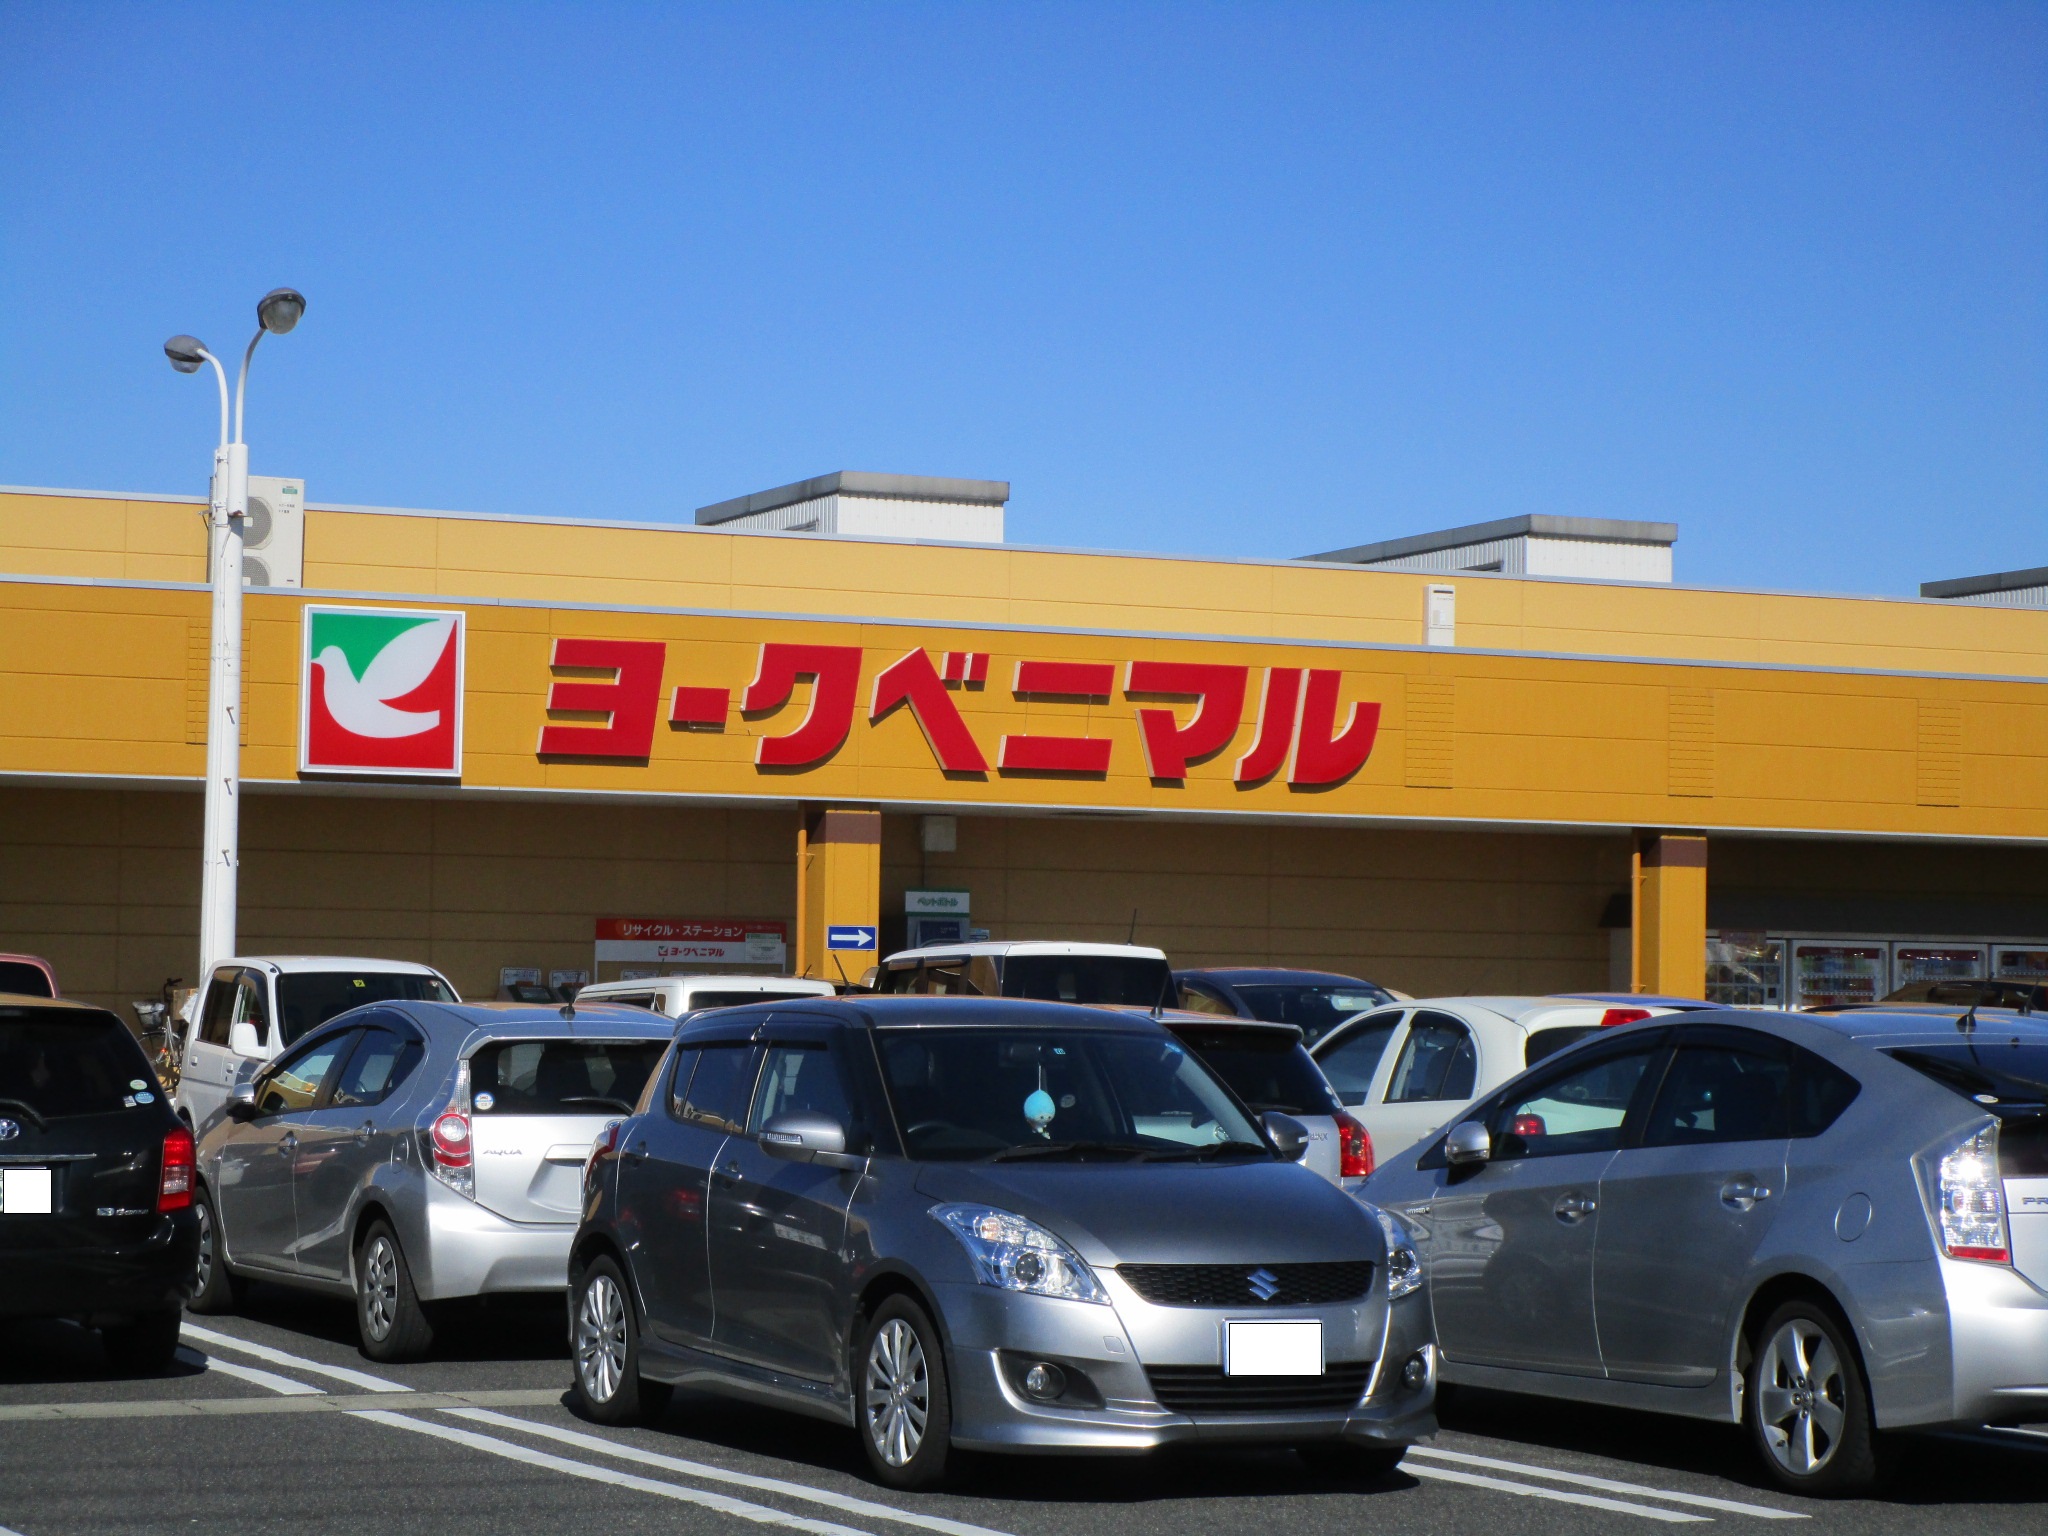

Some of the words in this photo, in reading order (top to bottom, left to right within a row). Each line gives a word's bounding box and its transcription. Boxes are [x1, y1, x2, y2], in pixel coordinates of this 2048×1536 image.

[536, 638, 1382, 784] ヨークベニマル
[623, 923, 743, 937] リサイクル・ステーション
[482, 1148, 523, 1156] AQUA
